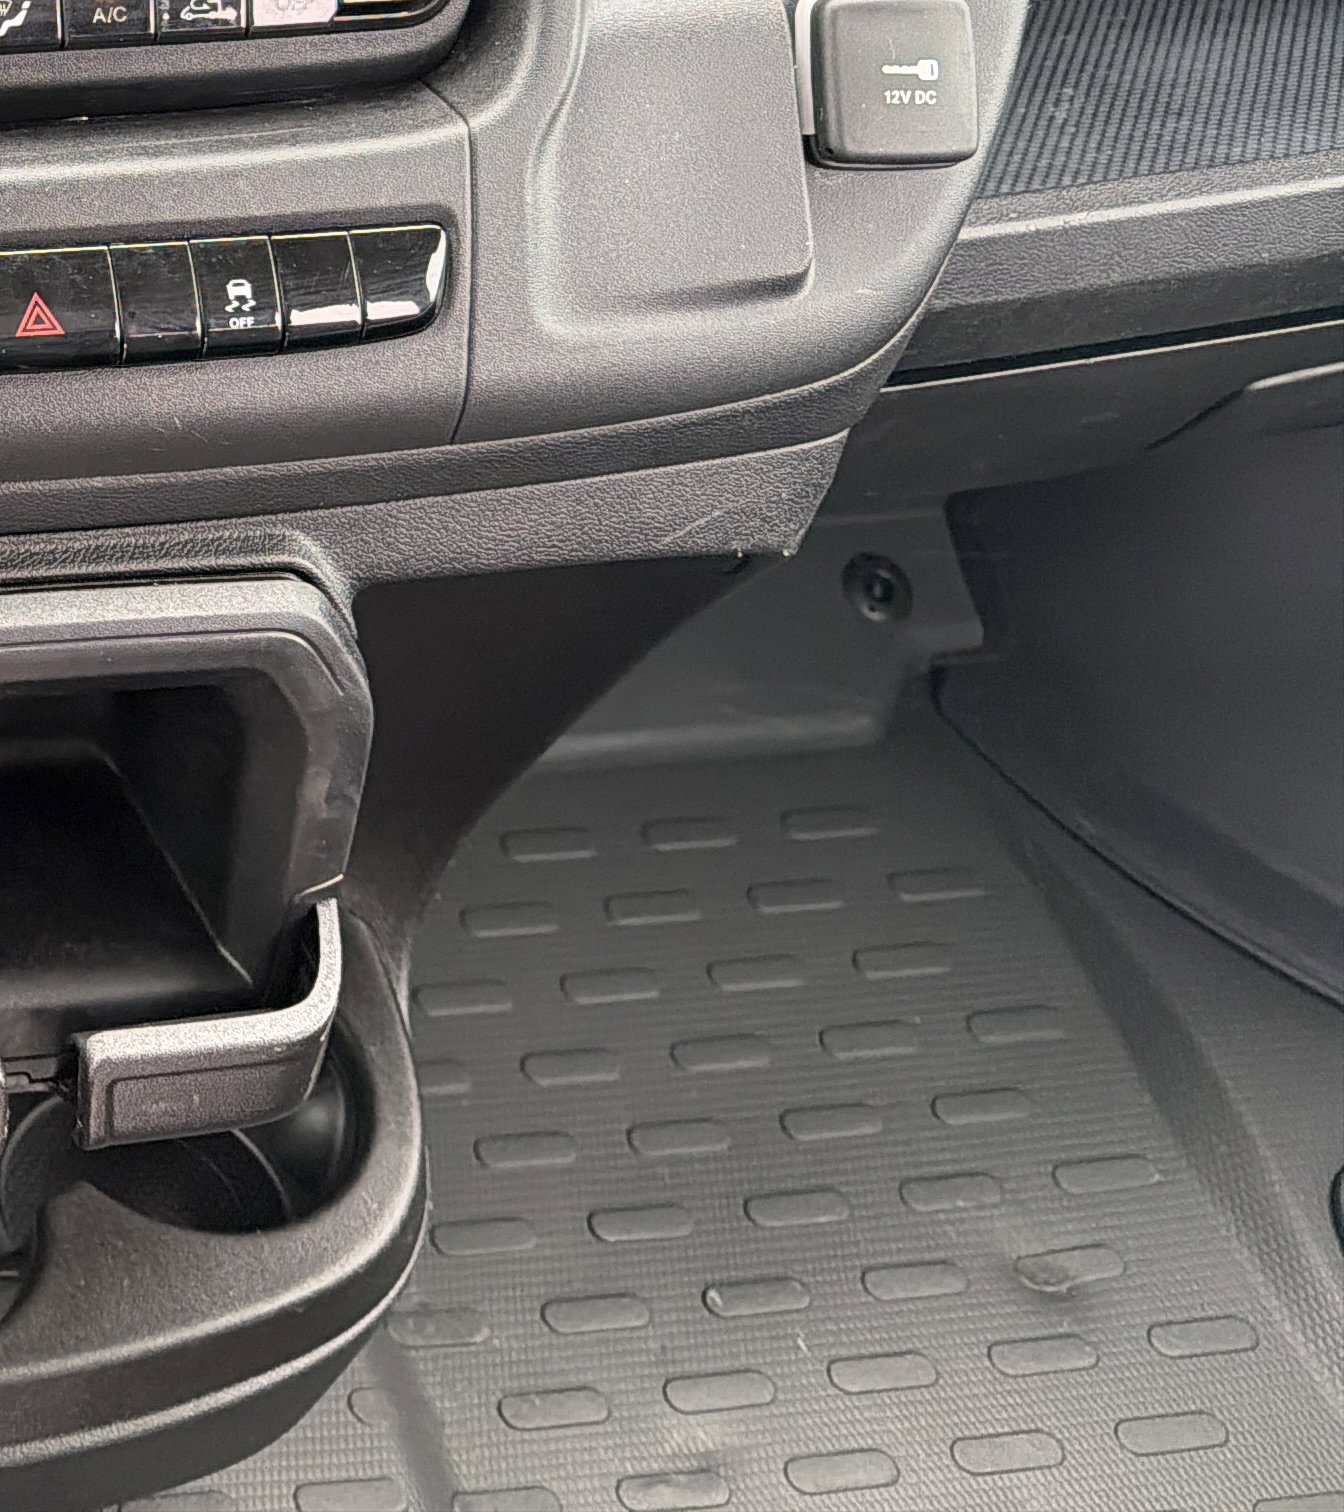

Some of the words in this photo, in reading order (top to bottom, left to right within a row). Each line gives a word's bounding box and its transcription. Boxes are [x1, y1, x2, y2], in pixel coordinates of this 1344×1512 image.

[92, 6, 128, 24] A/C
[883, 89, 911, 105] 12V
[914, 89, 937, 105] DC
[229, 317, 255, 329] OFF
